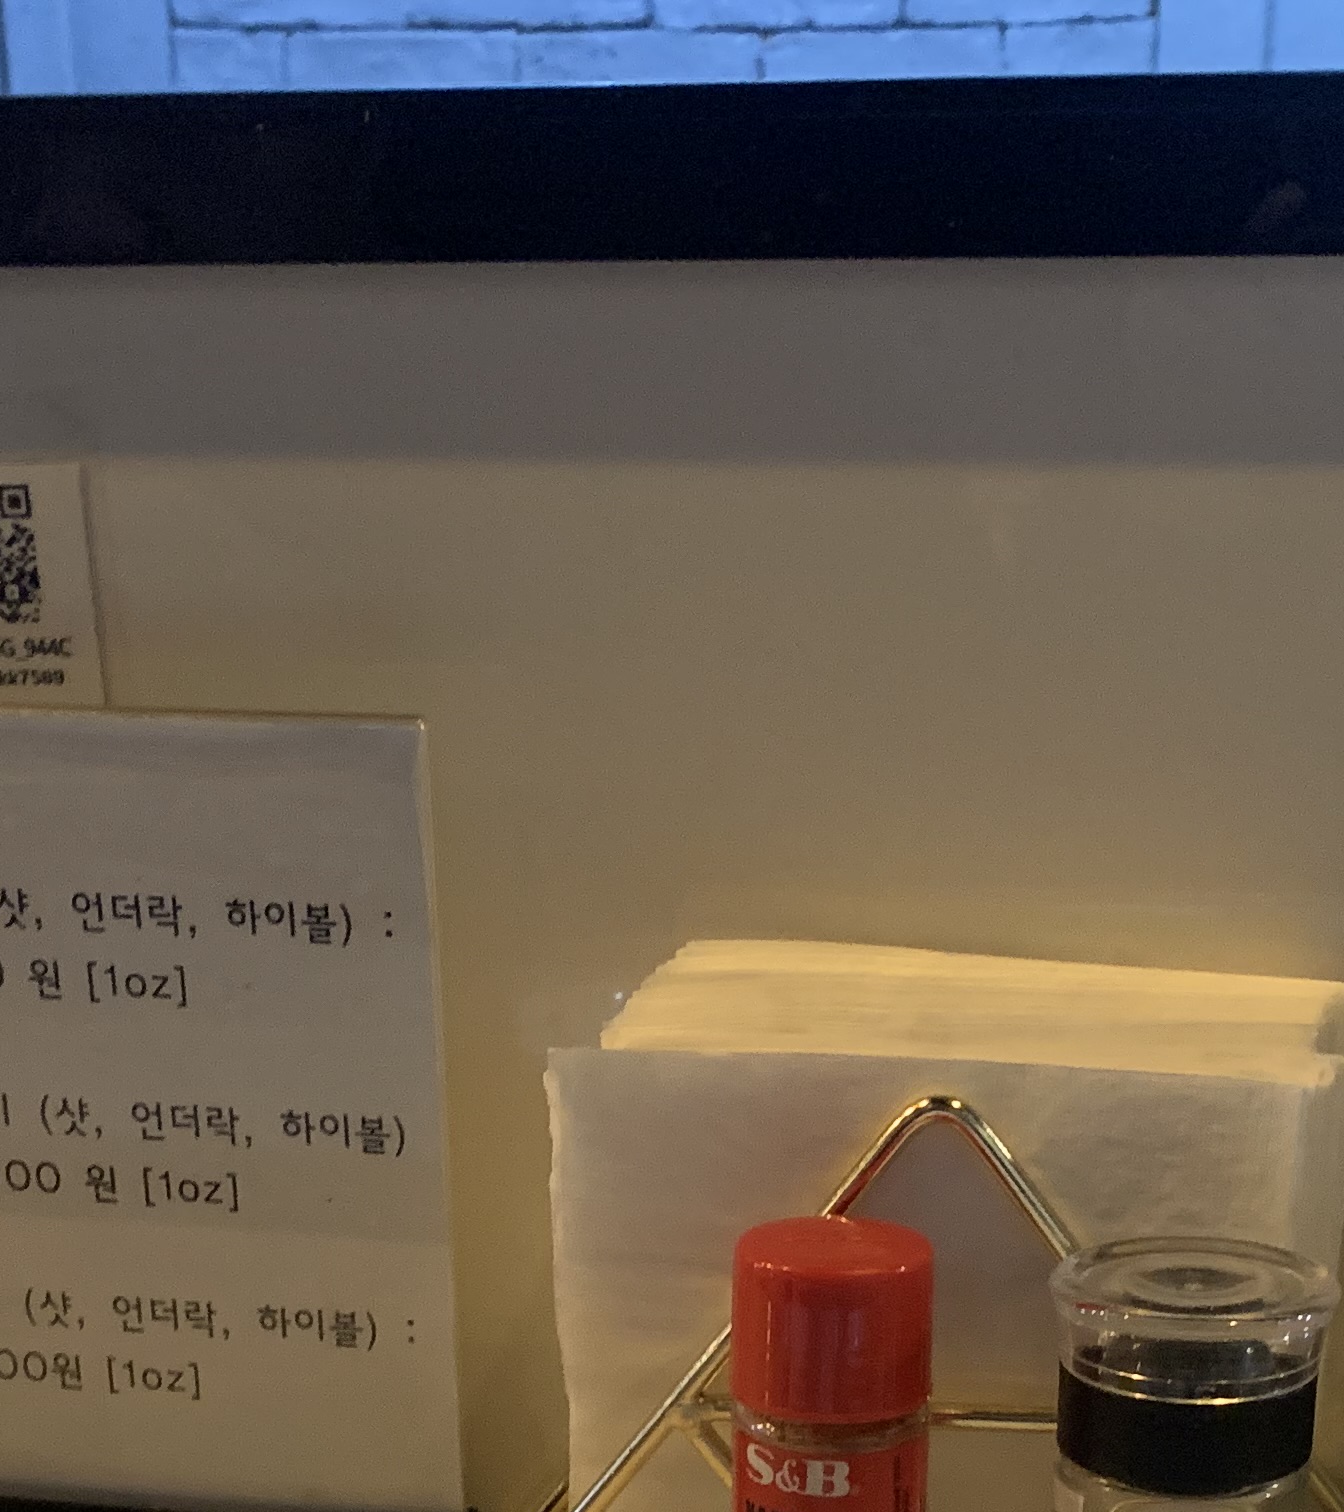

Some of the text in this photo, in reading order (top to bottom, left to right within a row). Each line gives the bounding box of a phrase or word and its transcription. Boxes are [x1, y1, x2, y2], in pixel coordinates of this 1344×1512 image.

[72, 891, 197, 938] 언더락,
[226, 898, 352, 947] 하이볼)
[29, 958, 61, 1001] 원
[87, 960, 188, 1008] [1oz]
[40, 1095, 103, 1139] (샷,
[131, 1100, 253, 1149] 언더락,
[281, 1108, 406, 1158] 하이볼)
[86, 1165, 117, 1203] 원
[143, 1167, 239, 1213] [1oz]
[25, 1287, 86, 1330] (샷,
[112, 1293, 229, 1340] 언더락,
[259, 1304, 378, 1352] 하이볼)
[107, 1357, 202, 1401] [1oz]
[746, 1442, 851, 1498] S&B
